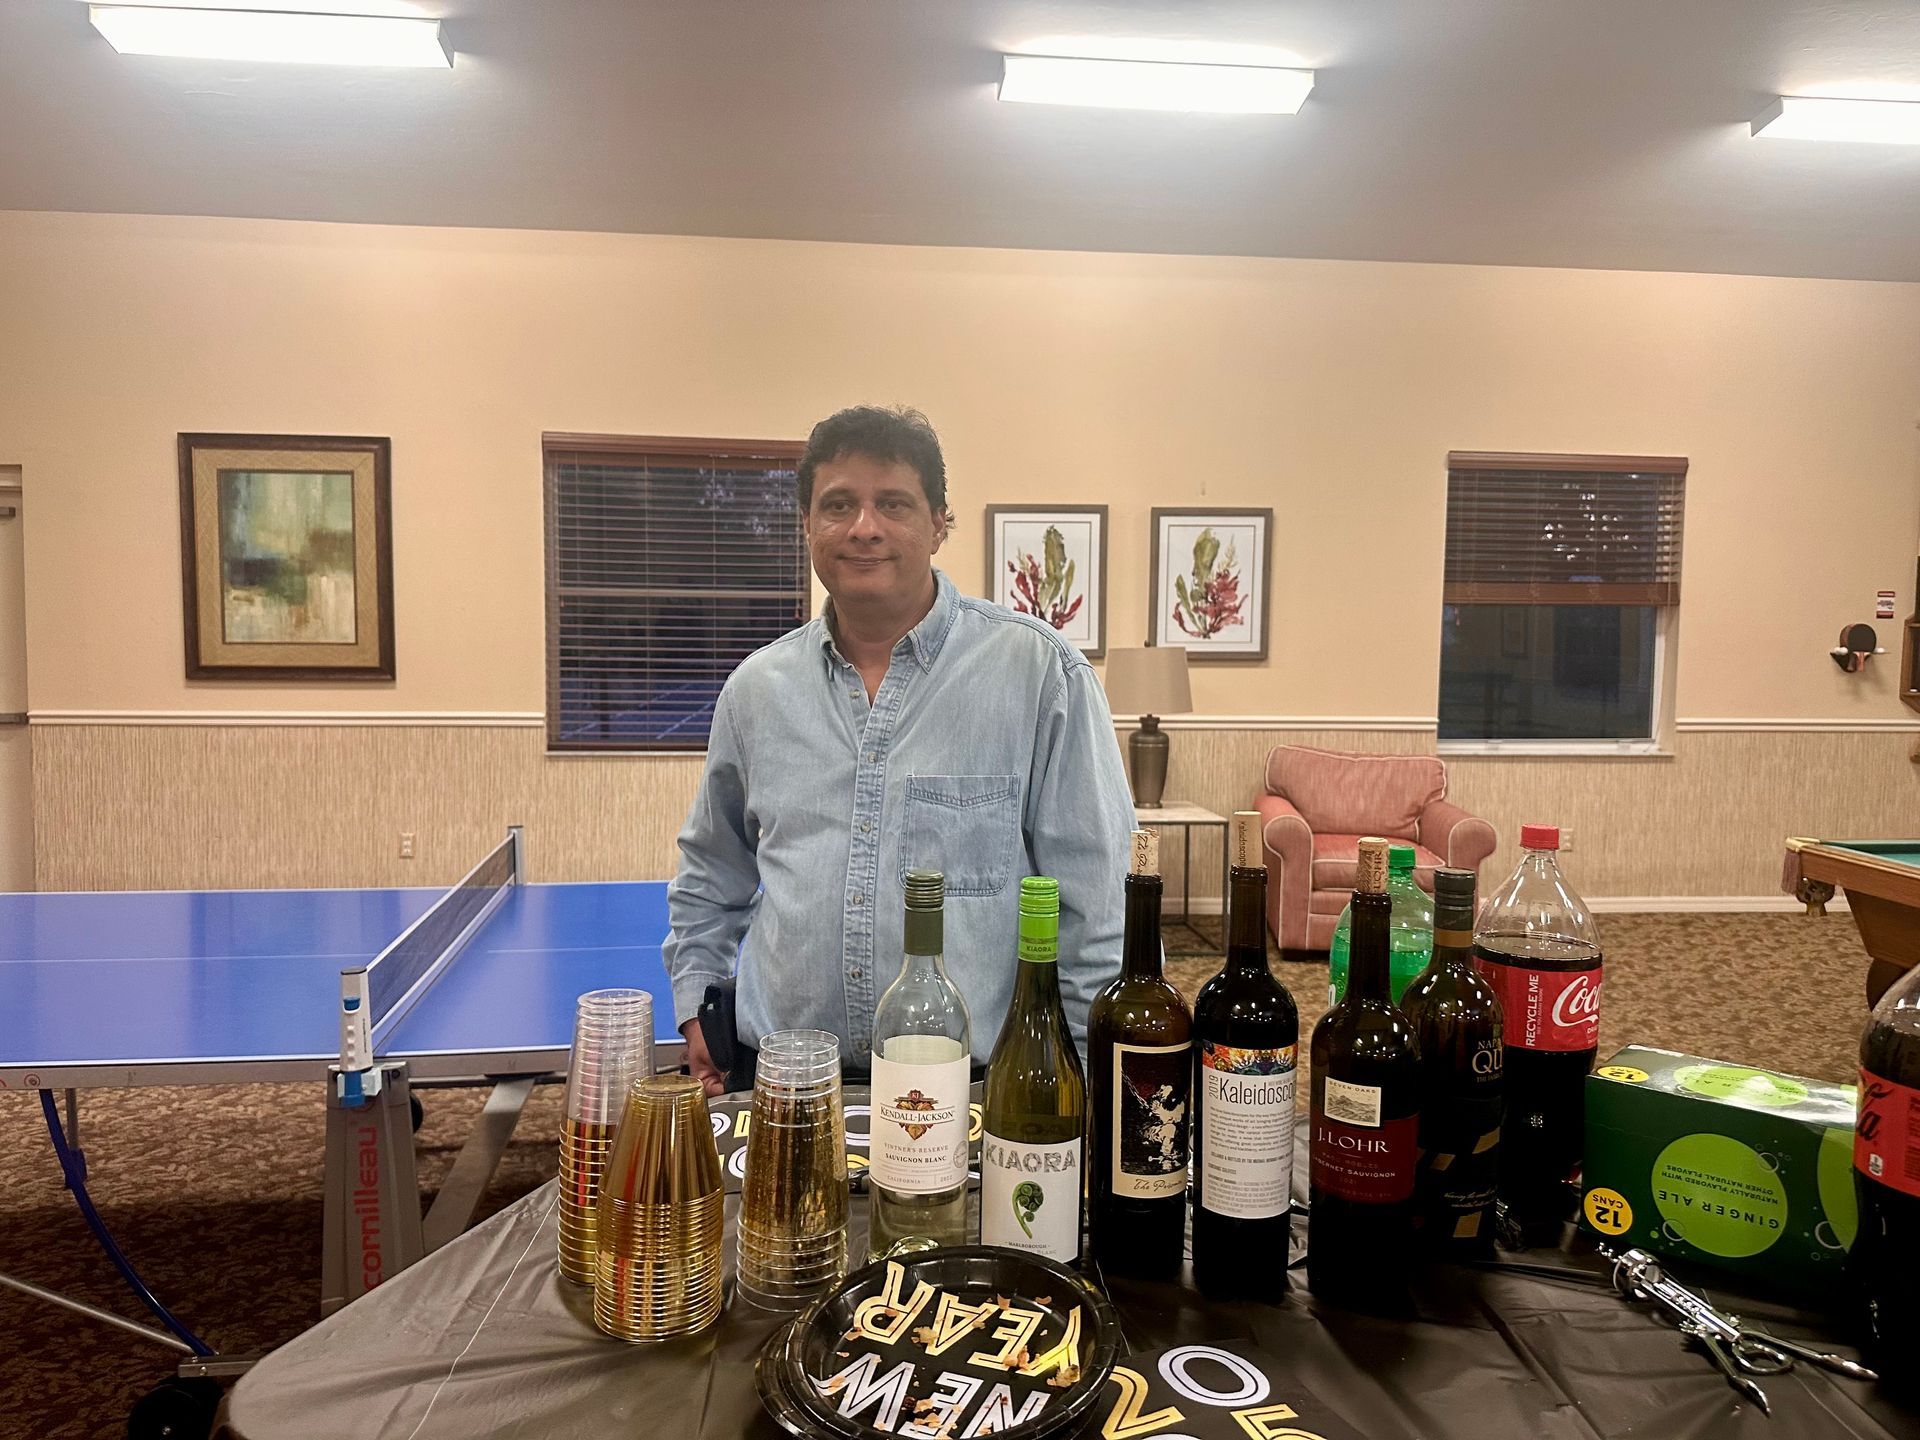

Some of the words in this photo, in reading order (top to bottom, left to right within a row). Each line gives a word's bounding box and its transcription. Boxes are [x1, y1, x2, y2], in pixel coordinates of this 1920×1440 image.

[1529, 974, 1539, 993] ME
[1526, 994, 1538, 1047] RECYCLE
[1208, 1074, 1219, 1099] 2019
[1329, 1081, 1352, 1090] SEVEN
[880, 1106, 954, 1122] KENDALL-JACKSON
[919, 1145, 949, 1153] RESERVE
[984, 1141, 1076, 1173] KIAORA
[885, 1153, 922, 1164] SAUVIGNON
[925, 1155, 947, 1163] BLANC
[887, 1175, 921, 1184] CALIFORNIA
[1347, 1169, 1396, 1178] SAUVIGNON
[1661, 1171, 1682, 1181] WITH
[1666, 1165, 1702, 1178] FLAVORS
[1133, 1178, 1149, 1190] The
[1685, 1177, 1728, 1192] FLAVORED
[1706, 1174, 1743, 1188] NATURAL
[1730, 1189, 1778, 1205] NATURALLY
[1745, 1184, 1774, 1195] OTHER
[1592, 1193, 1624, 1209] CANS
[1658, 1190, 1693, 1206] ALE
[352, 1126, 382, 1291] cornilleau
[1595, 1205, 1622, 1228] 12
[1702, 1201, 1779, 1229] GINGER
[1008, 1241, 1047, 1249] MARLBOROUGH
[852, 1260, 1081, 1383] YEAR
[808, 1352, 1051, 1440] NEW
